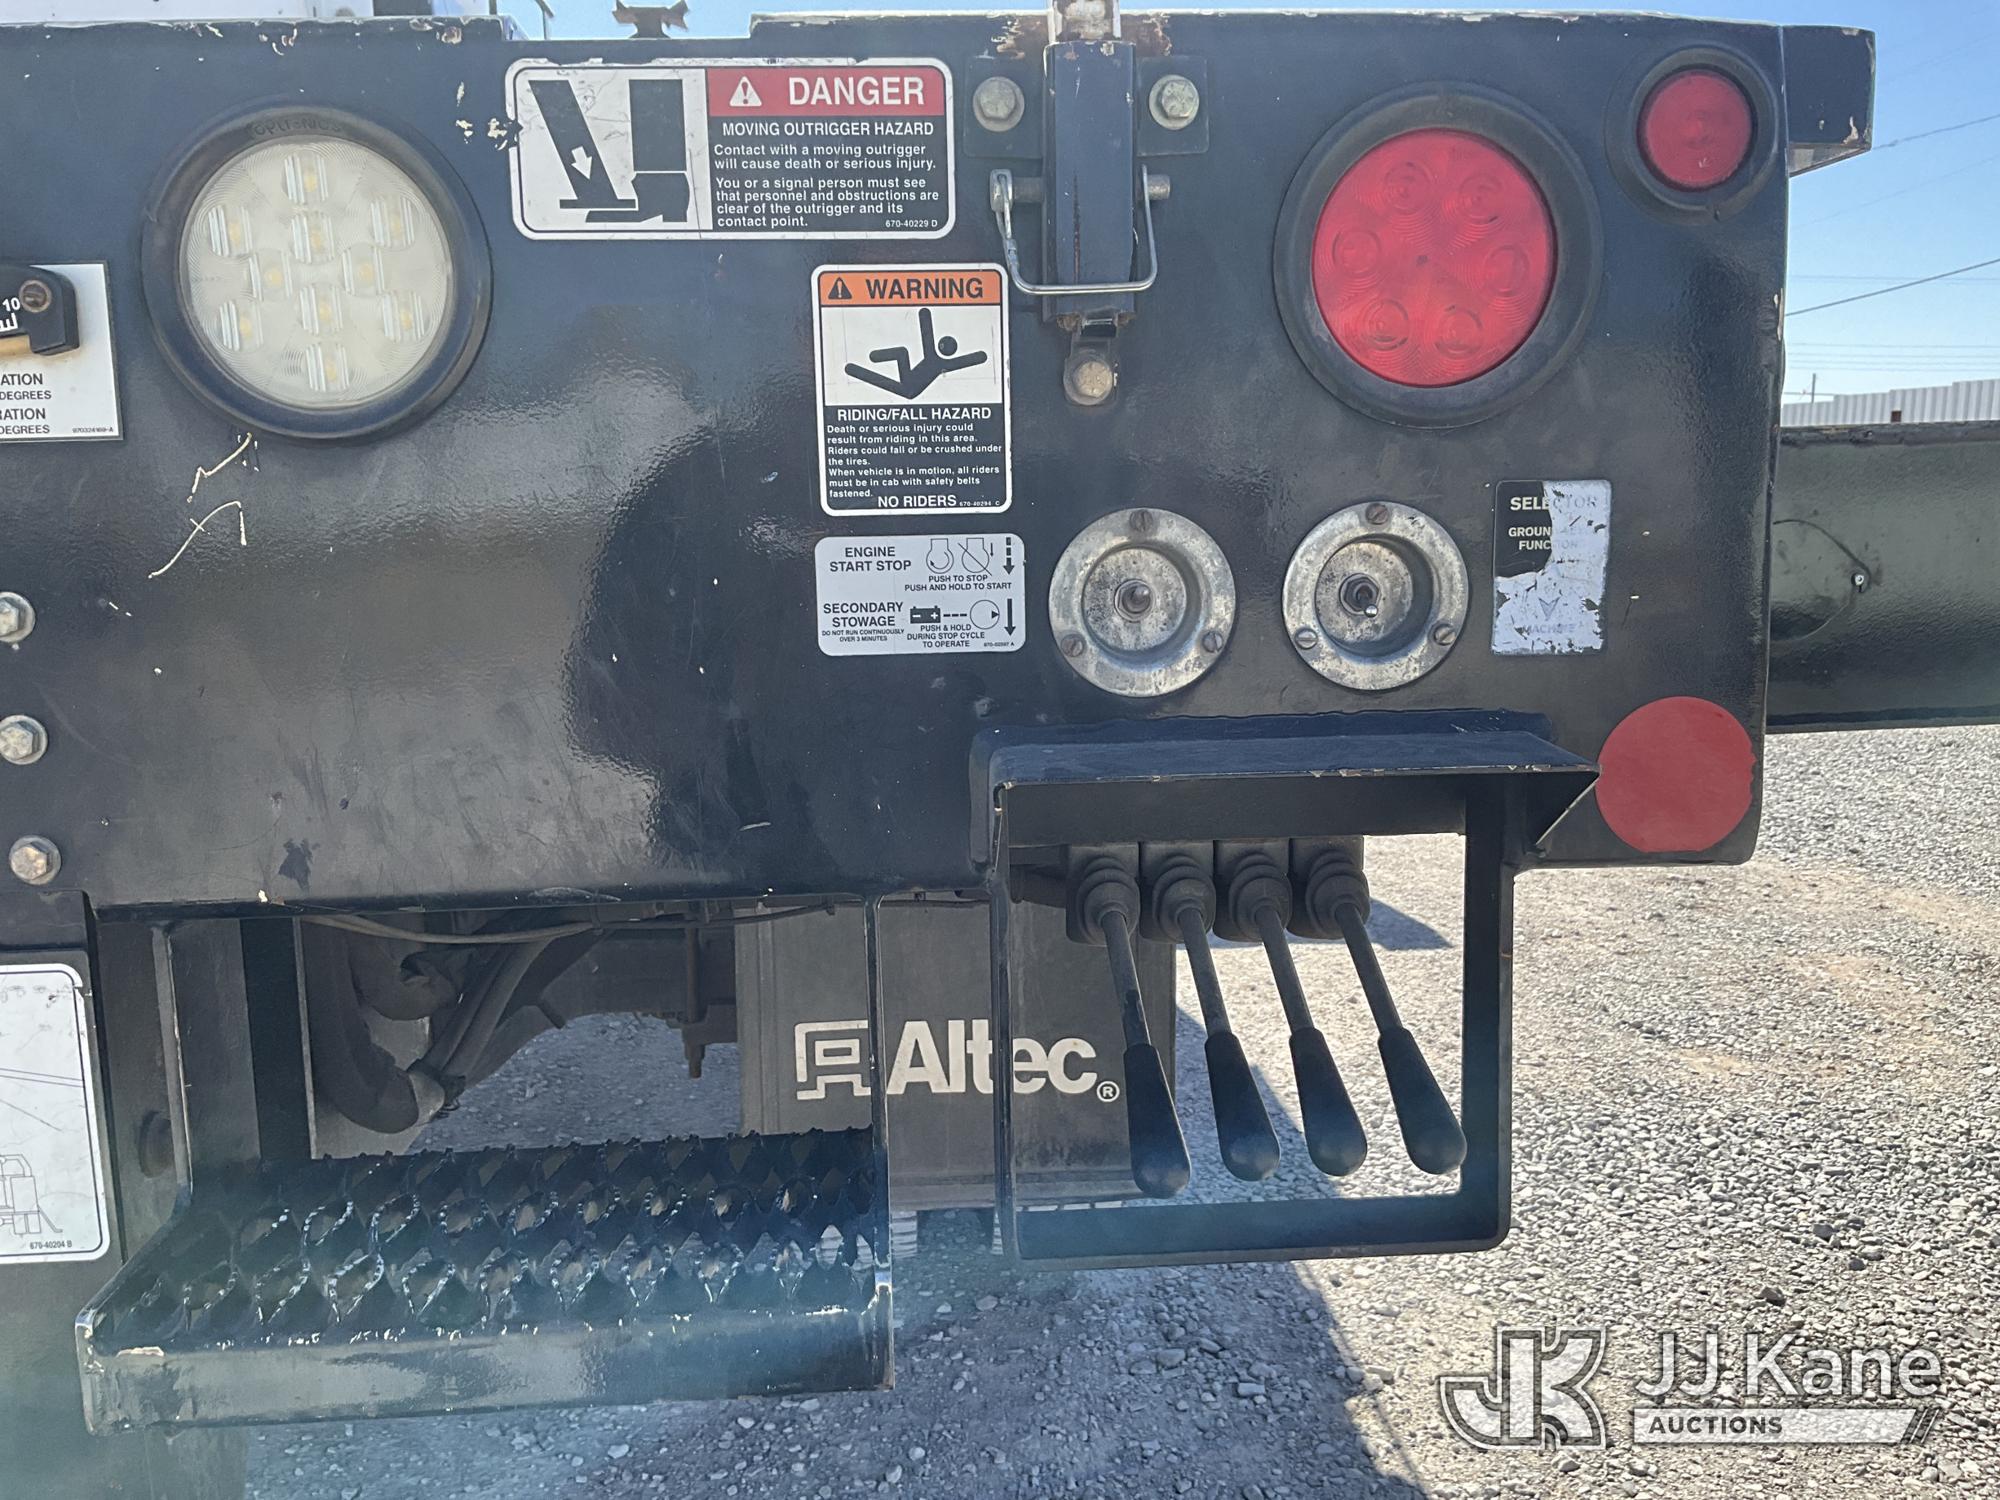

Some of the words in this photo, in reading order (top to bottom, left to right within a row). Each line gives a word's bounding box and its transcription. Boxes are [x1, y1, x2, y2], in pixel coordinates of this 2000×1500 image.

[788, 76, 924, 106] DANGER
[722, 122, 780, 136] MOVING
[784, 122, 870, 136] OUTRIGGER
[874, 122, 934, 136] HAZARD
[714, 144, 765, 156] Contact
[770, 144, 797, 156] with
[801, 145, 809, 155] a
[813, 144, 862, 158] moving
[866, 144, 925, 157] outrigger
[715, 158, 737, 169] will
[741, 160, 780, 169] cause
[784, 158, 821, 169] death
[825, 160, 839, 168] or
[843, 158, 892, 169] serious
[896, 158, 936, 172] injury.
[716, 177, 740, 189] You
[744, 180, 758, 189] or
[762, 180, 770, 189] a
[774, 177, 813, 192] signal
[818, 179, 863, 191] person
[867, 176, 899, 188] must
[903, 178, 926, 188] see
[716, 191, 740, 201] that
[744, 191, 806, 204] personnel
[811, 190, 834, 201] and
[837, 189, 916, 201] obstructions
[919, 191, 939, 200] are
[717, 203, 749, 214] clear
[753, 202, 766, 214] of
[770, 203, 791, 214] the
[794, 202, 855, 216] outrigger
[859, 202, 883, 214] and
[887, 202, 904, 214] its
[717, 215, 767, 227] contact
[771, 215, 808, 229] point.
[885, 220, 929, 228] 670-40229
[931, 220, 938, 228] D
[866, 278, 983, 299] WARNING
[3, 297, 20, 311] 10
[837, 408, 928, 421] RIDING/FALL
[931, 407, 991, 419] HAZARD
[827, 424, 856, 434] Death
[859, 425, 870, 433] or
[872, 424, 910, 433] serious
[913, 423, 942, 434] injury
[945, 422, 974, 432] could
[827, 435, 857, 444] result
[859, 434, 883, 443] from
[886, 434, 916, 445] riding
[918, 434, 928, 443] in
[931, 433, 950, 443] this
[828, 446, 858, 455] Riders
[861, 446, 888, 455] could
[890, 445, 905, 454] fall
[920, 445, 932, 453] be
[934, 444, 973, 453] crushed
[975, 444, 1002, 452] under
[828, 458, 844, 466] the
[846, 457, 871, 466] tires.
[829, 467, 856, 477] When
[857, 467, 893, 476] vehicle
[895, 467, 904, 476] is
[906, 467, 916, 475] in
[918, 466, 955, 475] motion,
[957, 466, 969, 474] all
[971, 465, 1000, 474] riders
[829, 479, 853, 488] must
[855, 478, 868, 488] be
[870, 478, 880, 487] in
[882, 478, 900, 487] cab
[901, 477, 923, 486] with
[925, 476, 954, 487] safety
[956, 476, 981, 485] belts
[829, 489, 874, 498] fastened.
[878, 495, 899, 508] NO
[903, 494, 957, 507] RIDERS
[845, 546, 896, 558] ENGINE
[829, 561, 873, 572] START
[876, 560, 912, 571] STOP
[928, 575, 951, 583] PUSH
[966, 574, 989, 582] STOP
[904, 584, 927, 592] PUSH
[949, 583, 972, 591] HOLD
[986, 582, 1012, 590] START
[823, 602, 904, 614] SECONDARY
[832, 616, 896, 628] STOWAGE
[943, 624, 949, 632] &
[907, 633, 937, 641] DURING
[938, 632, 958, 640] STOP
